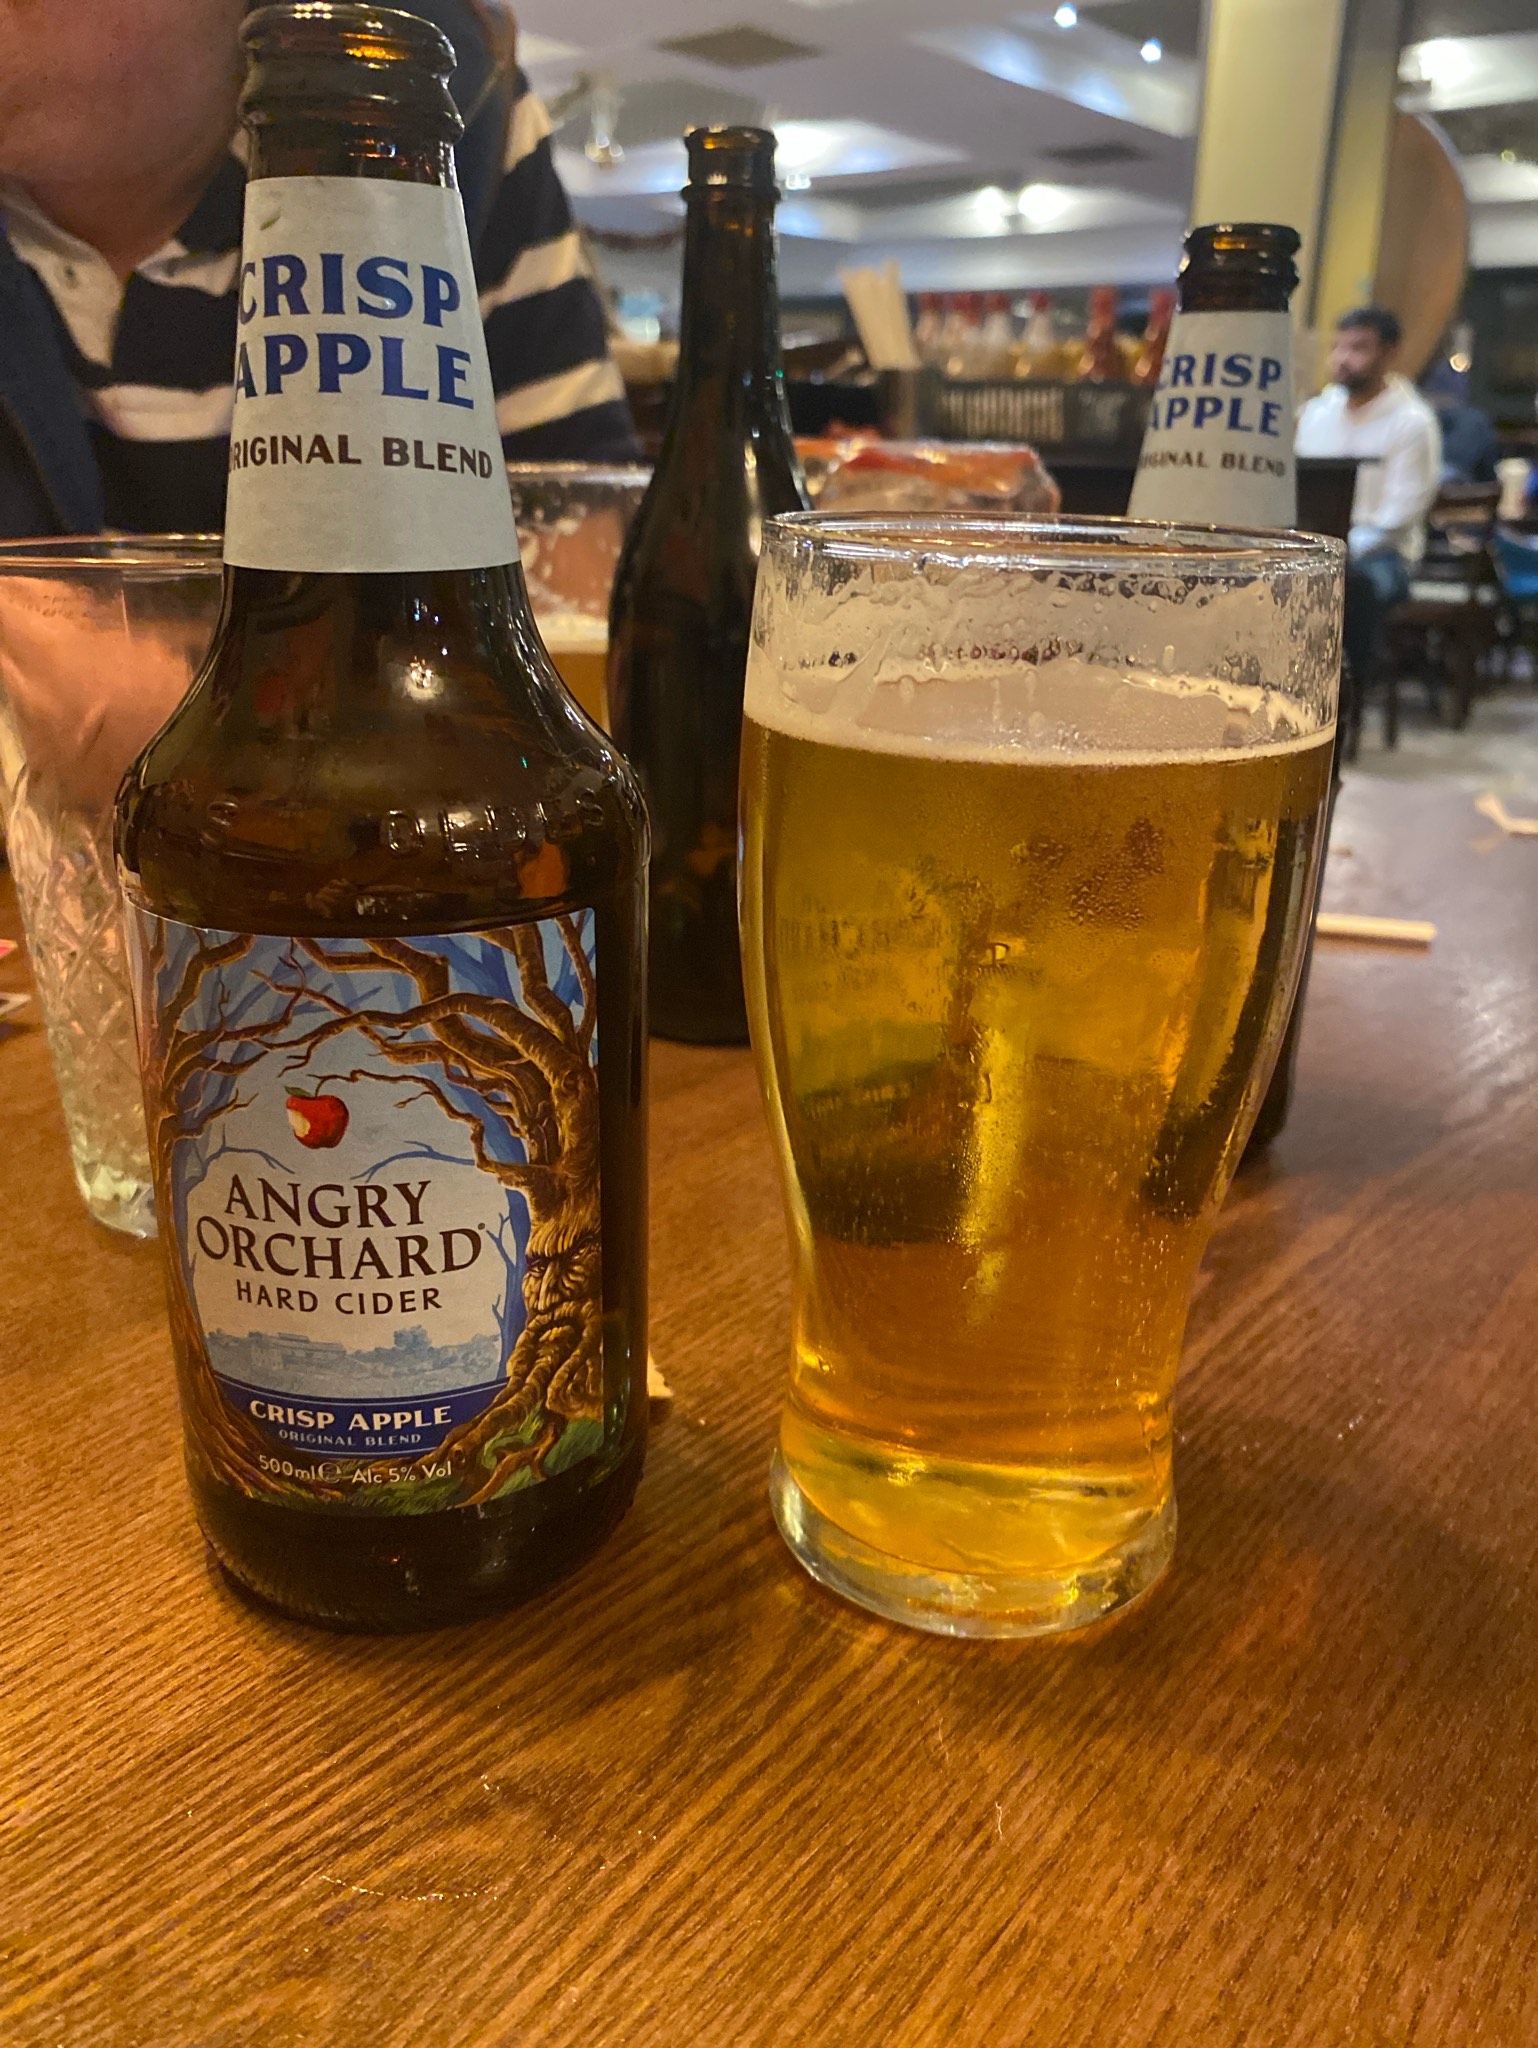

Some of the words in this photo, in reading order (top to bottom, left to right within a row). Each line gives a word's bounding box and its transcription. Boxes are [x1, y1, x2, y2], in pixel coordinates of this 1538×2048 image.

[239, 253, 461, 328] CRISP
[234, 333, 475, 410] APPLE
[1156, 352, 1283, 392] RISP
[229, 433, 362, 473] RIGINAL
[383, 436, 494, 480] BLEND
[1220, 452, 1287, 478] BLEND
[224, 1173, 432, 1230] ANGRY
[236, 1278, 319, 1314] HARD
[335, 1287, 443, 1316] CIDER
[249, 1399, 336, 1430] CRISP
[348, 1405, 453, 1432] APPLE
[278, 1428, 354, 1447] ORIGINAL
[365, 1432, 422, 1447] BLEND
[352, 1467, 383, 1484] Alc
[389, 1466, 417, 1483] 5%
[422, 1460, 452, 1480] Vol
